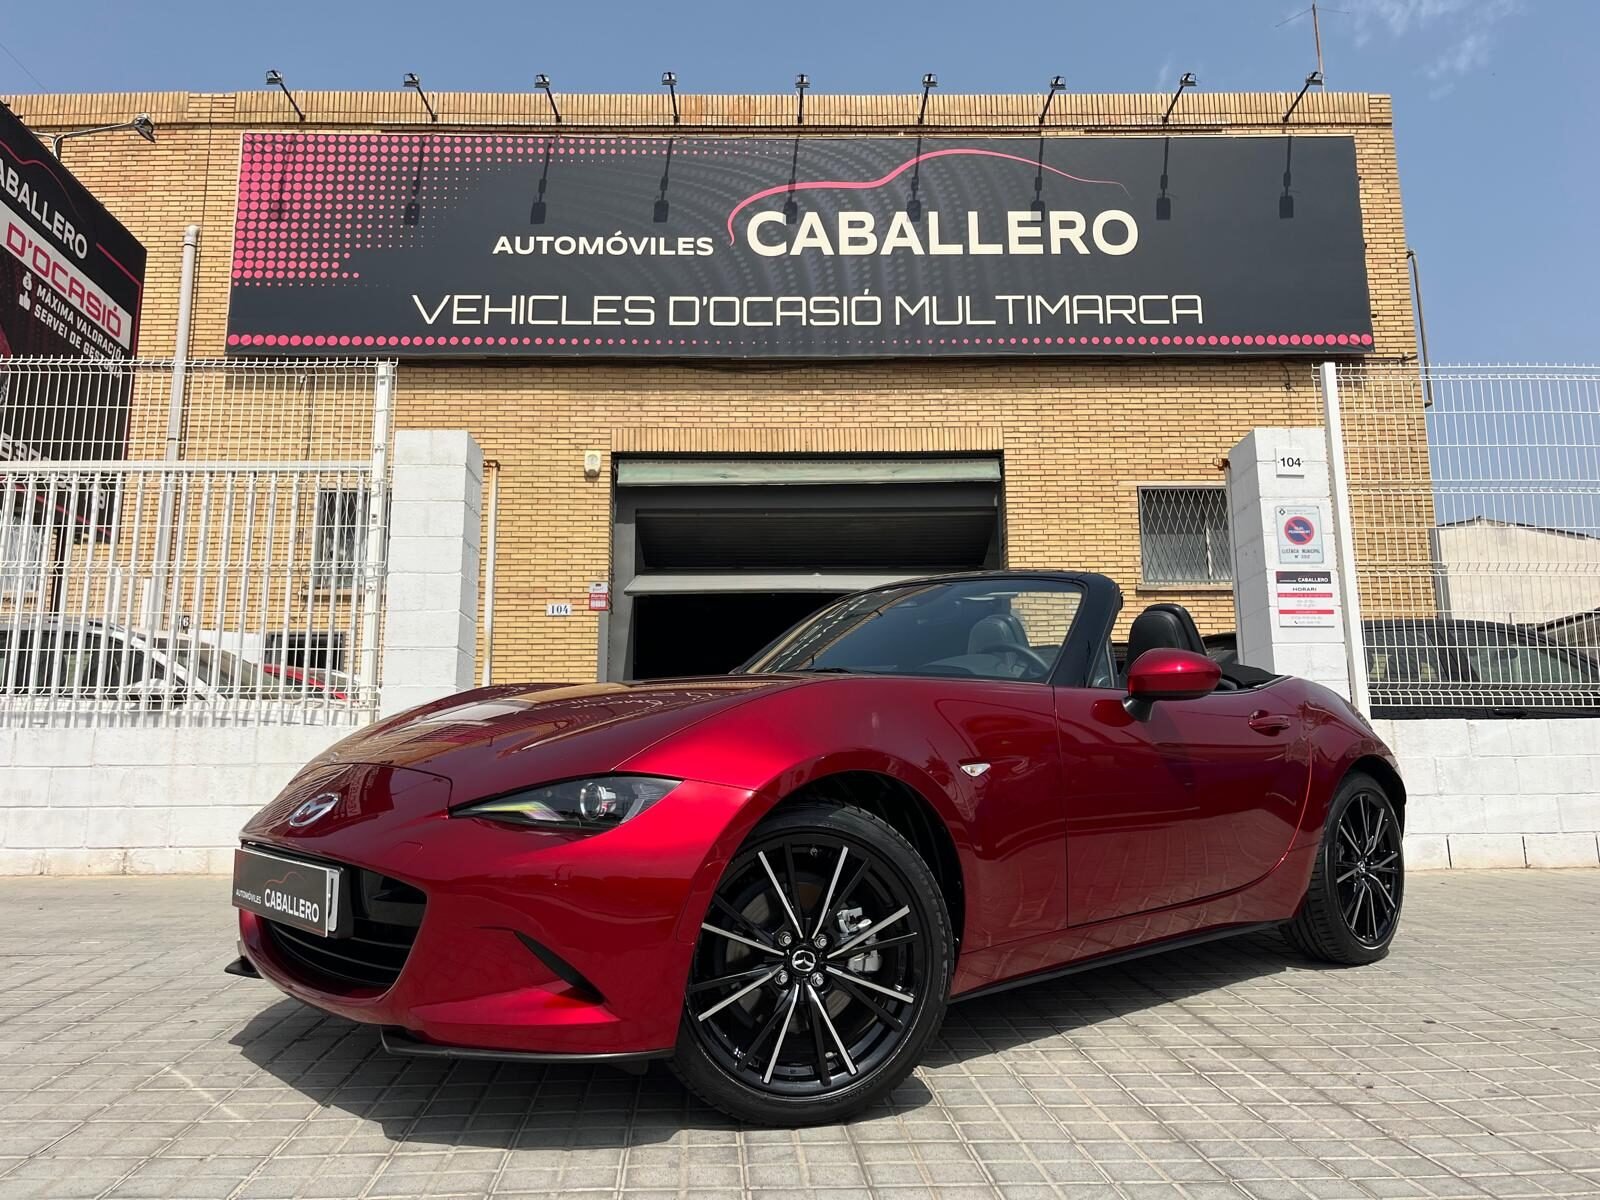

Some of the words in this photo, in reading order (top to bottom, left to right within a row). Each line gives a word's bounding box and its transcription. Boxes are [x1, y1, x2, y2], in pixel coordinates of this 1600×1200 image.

[492, 230, 714, 257] AUTOMÓVILES
[746, 209, 1139, 257] CABALLERO
[6, 221, 122, 338] D'OCASIÓ
[34, 303, 68, 339] SERVEI
[69, 330, 82, 350] DE
[411, 294, 656, 327] VEHICLES
[668, 288, 882, 327] D'OCASIÓ
[895, 294, 1205, 326] MULTIMARCA
[1280, 456, 1302, 468] 104
[551, 605, 568, 614] 104
[264, 888, 320, 923] CABALLERO
